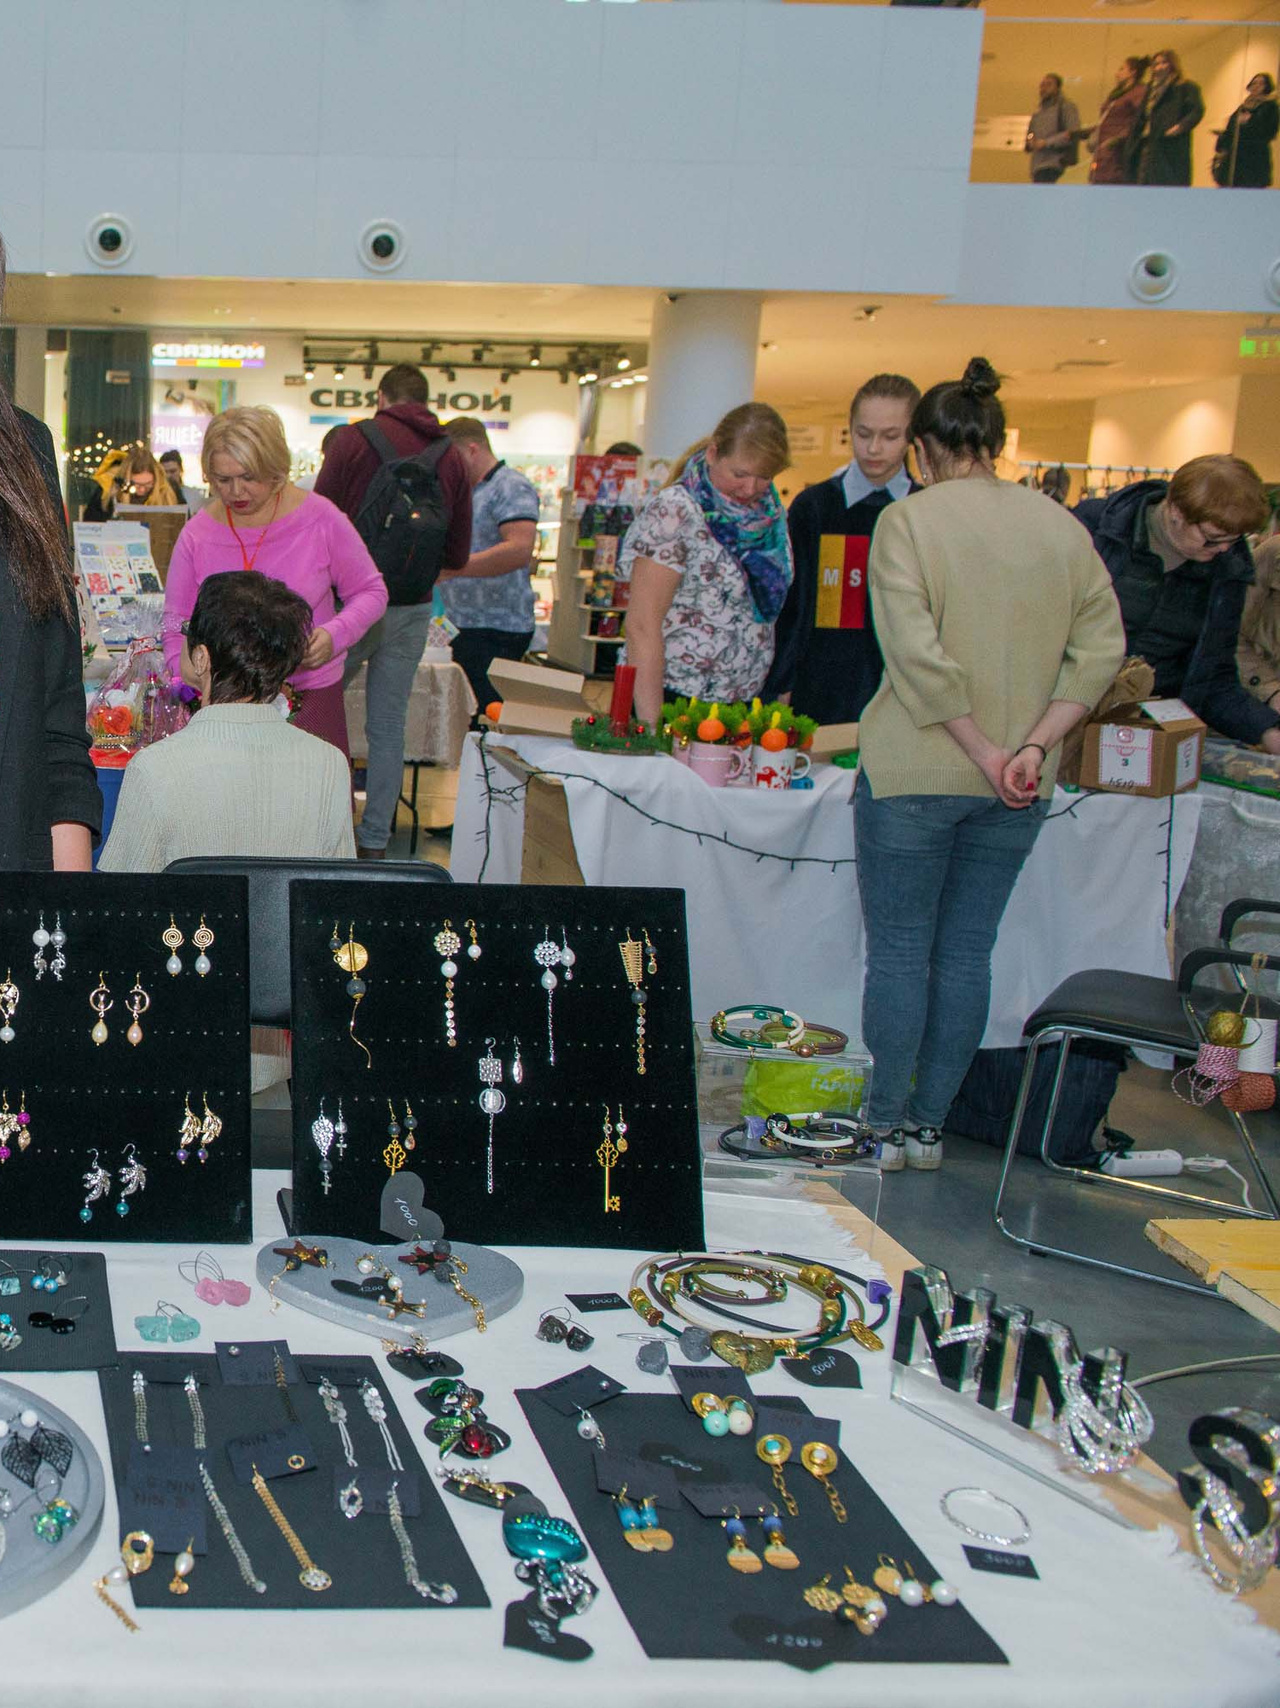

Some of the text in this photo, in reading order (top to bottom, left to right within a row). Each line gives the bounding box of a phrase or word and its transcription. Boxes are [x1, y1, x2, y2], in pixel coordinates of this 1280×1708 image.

[152, 341, 266, 358] СВЯЗНОЙ
[822, 567, 863, 588] M S
[394, 1197, 419, 1227] 1000
